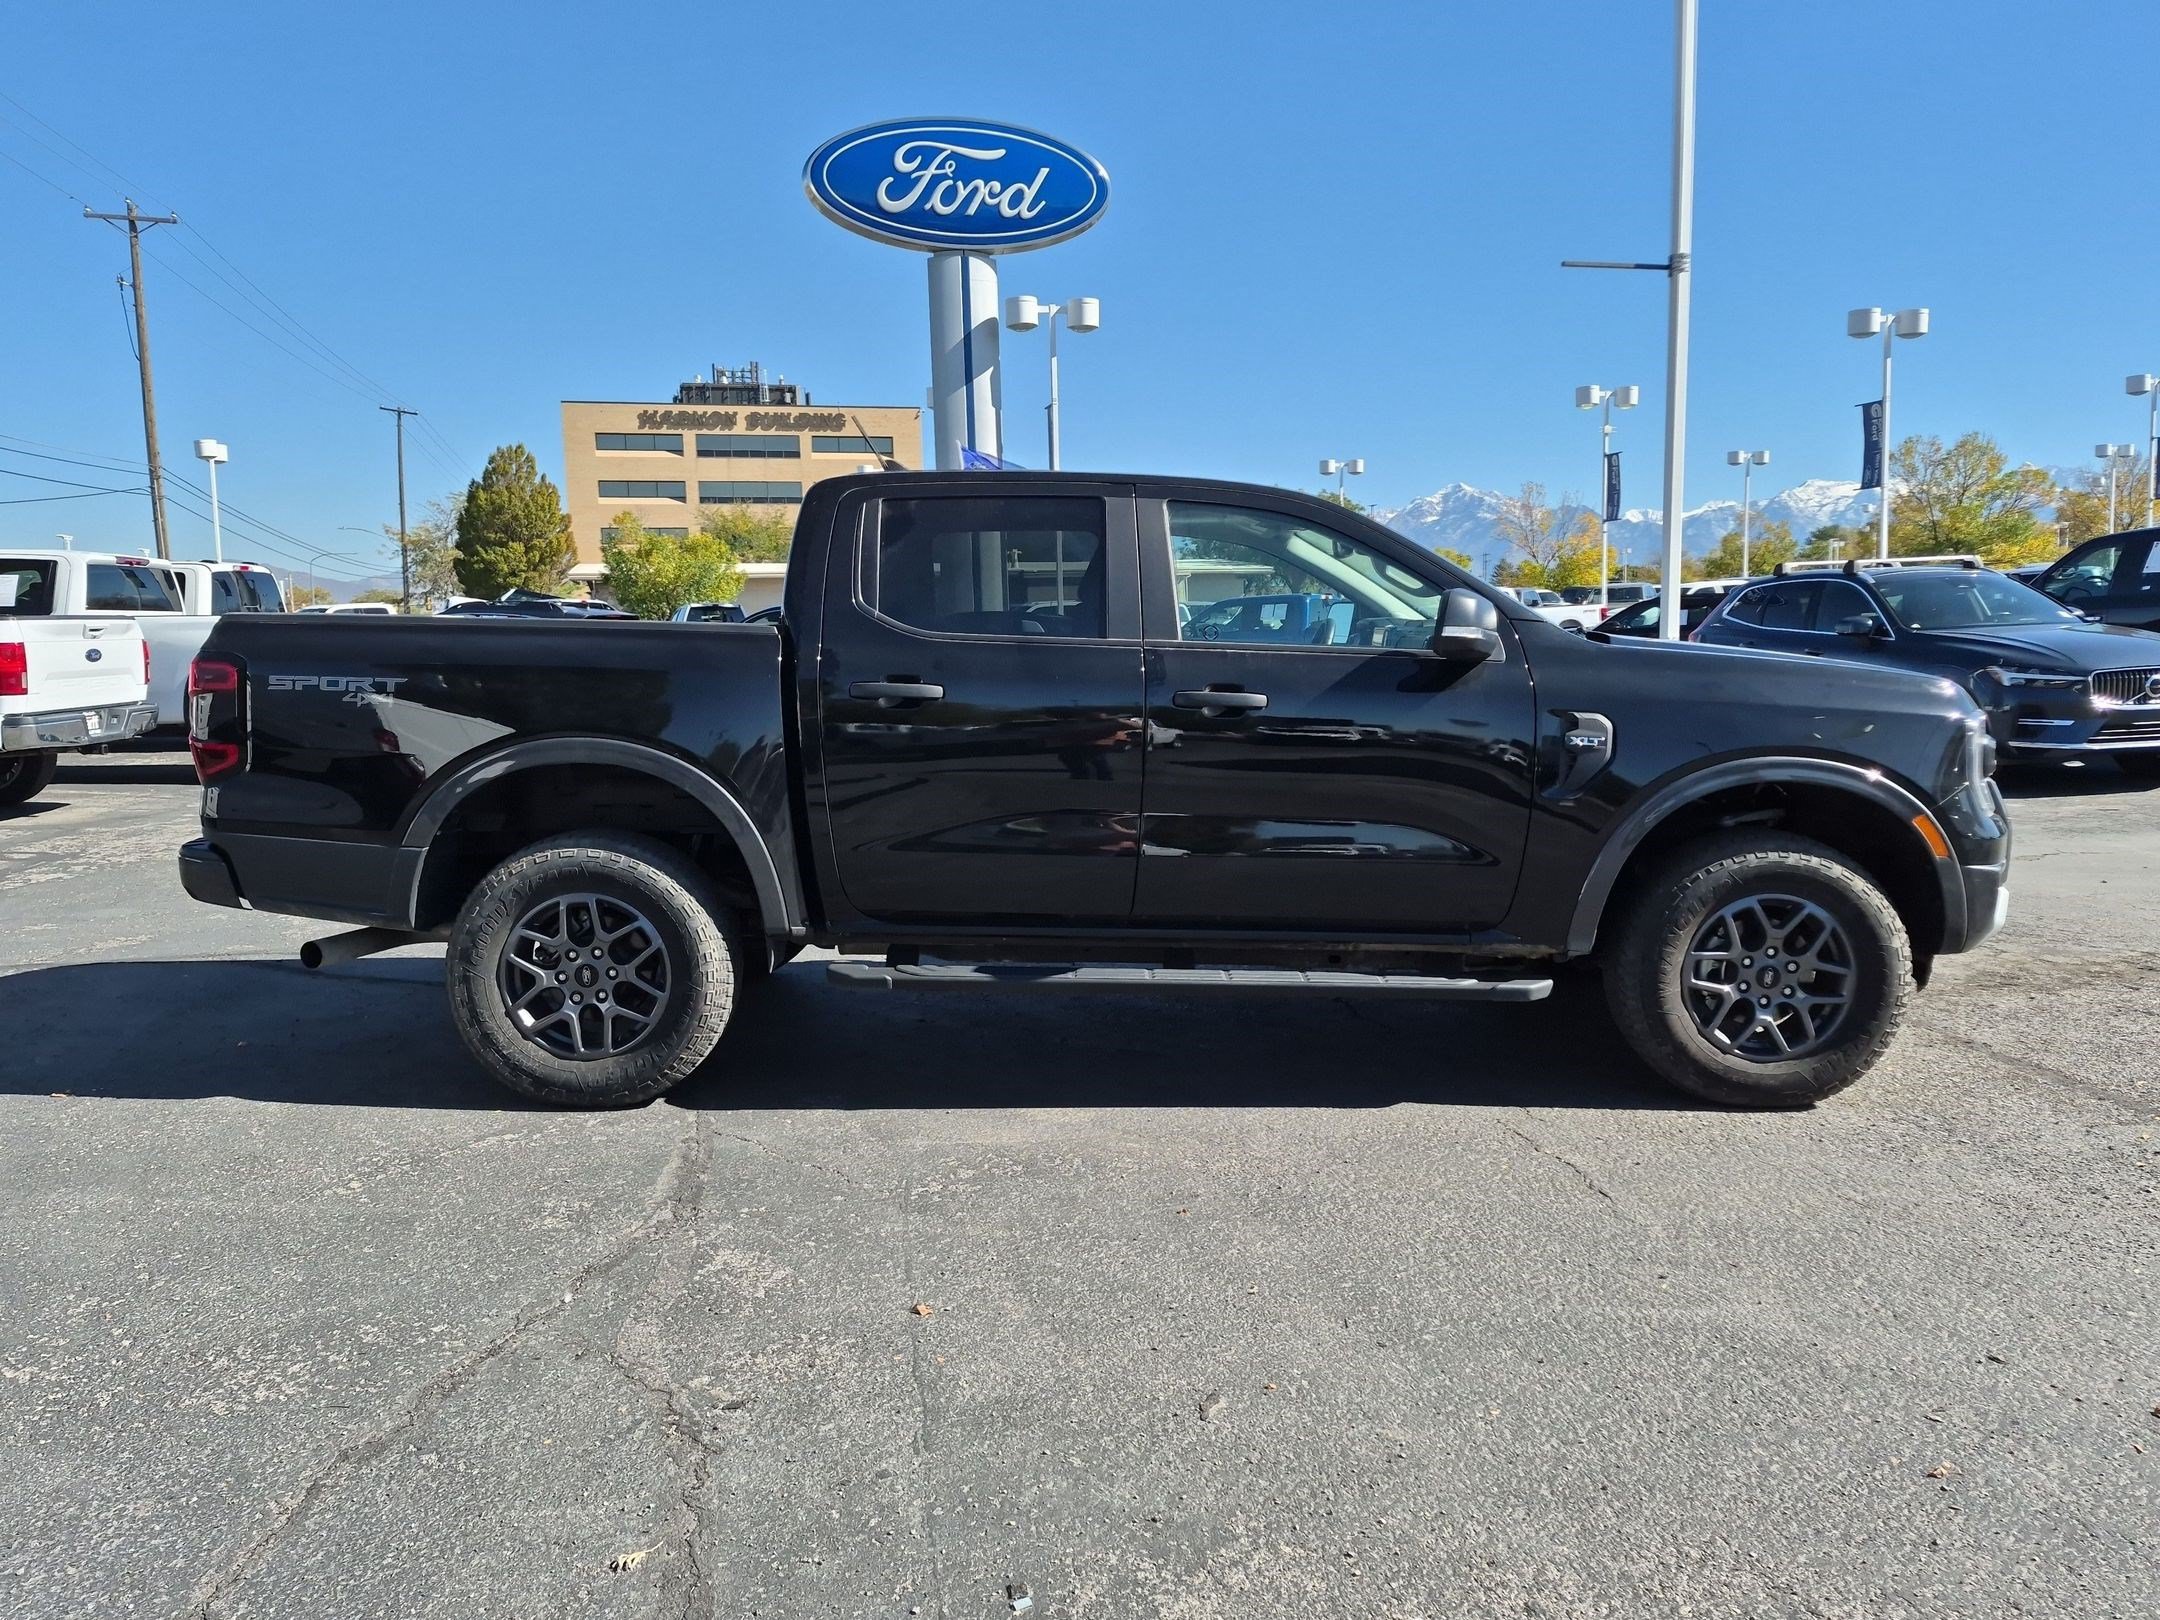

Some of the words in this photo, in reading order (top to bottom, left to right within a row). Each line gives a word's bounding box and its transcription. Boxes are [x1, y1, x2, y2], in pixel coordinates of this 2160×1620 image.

[877, 141, 1050, 220] Ford
[745, 411, 846, 432] BUILDING
[267, 675, 408, 692] SPORT
[1569, 736, 1606, 747] XLT
